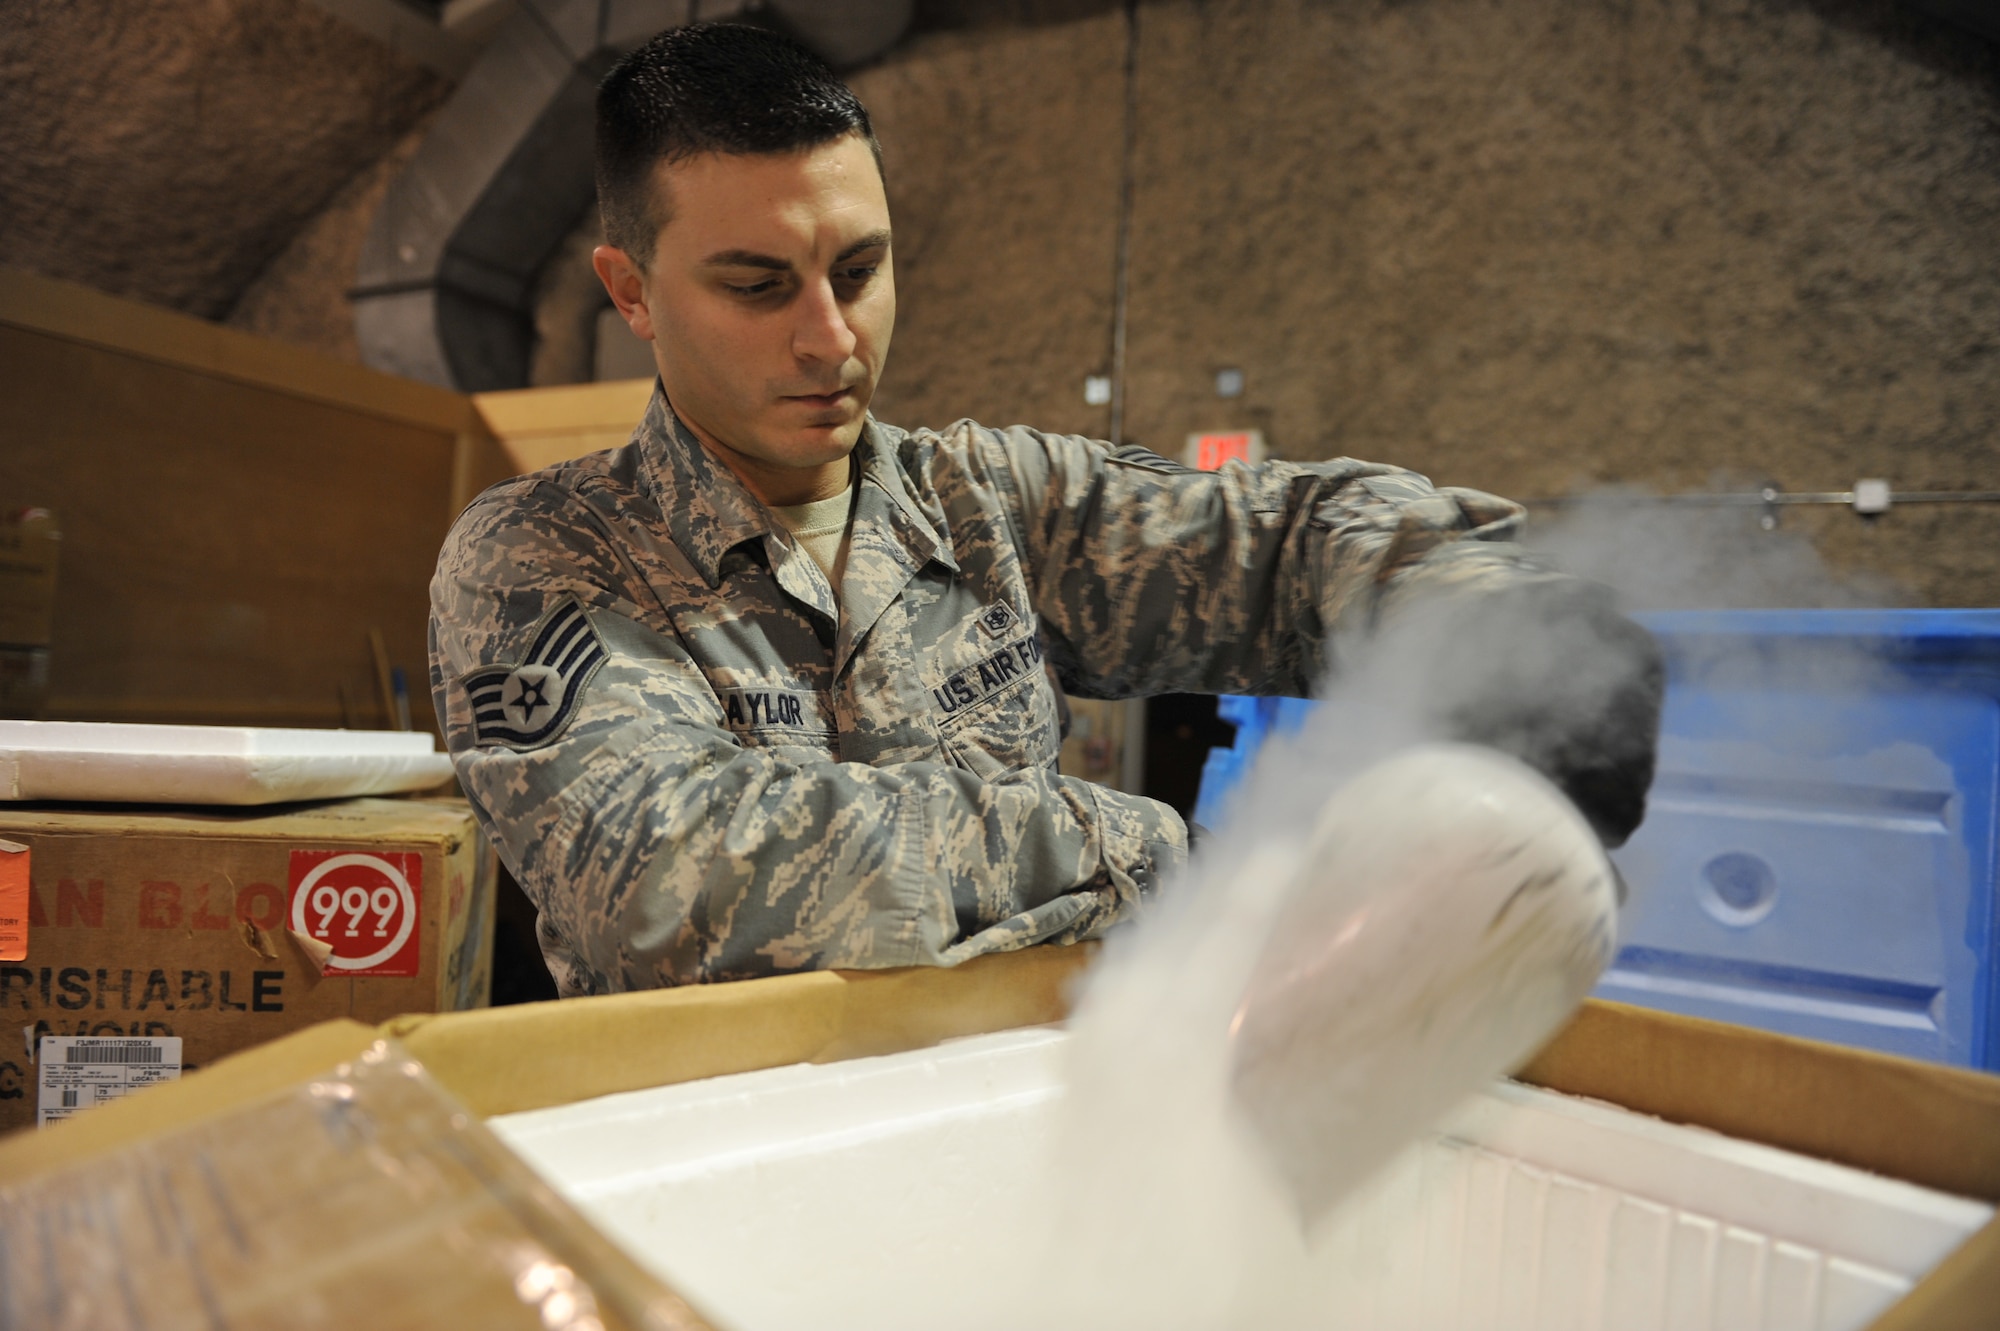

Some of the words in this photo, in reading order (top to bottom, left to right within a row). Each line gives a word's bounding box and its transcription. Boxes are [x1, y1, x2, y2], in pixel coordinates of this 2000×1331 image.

[977, 647, 1021, 692] AIR
[717, 692, 804, 726] AYLOR
[312, 886, 398, 937] 999
